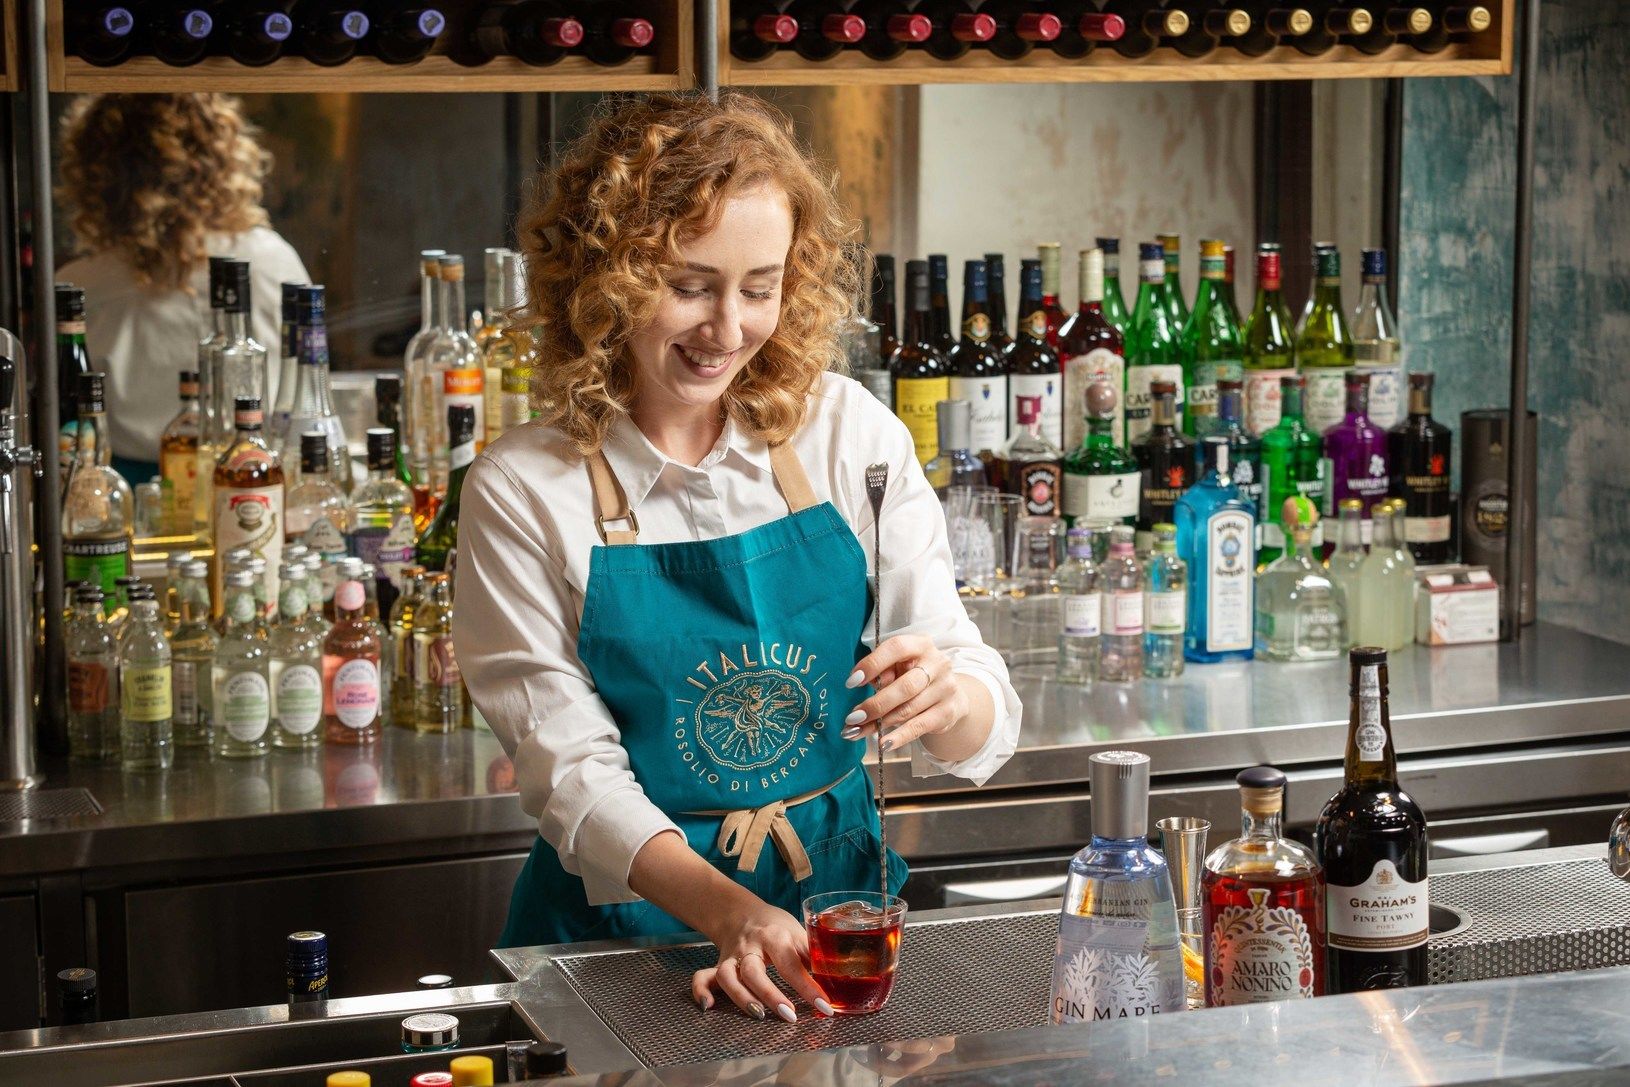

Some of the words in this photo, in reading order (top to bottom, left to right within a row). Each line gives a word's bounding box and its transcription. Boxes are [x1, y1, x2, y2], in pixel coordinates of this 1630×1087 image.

[1127, 394, 1151, 406] CAR
[1192, 390, 1217, 402] CAR
[686, 641, 817, 690] ITALICUS
[675, 716, 720, 784] ROSOLIO
[730, 780, 749, 792] DI
[760, 688, 829, 790] BERGAMOTTO
[1349, 895, 1417, 909] GRAHAM'S
[1353, 913, 1378, 923] FINE
[1383, 911, 1415, 922] TAWNY
[1231, 960, 1292, 977] AMARO
[1231, 975, 1293, 993] NONINO
[1054, 996, 1086, 1020] GIN
